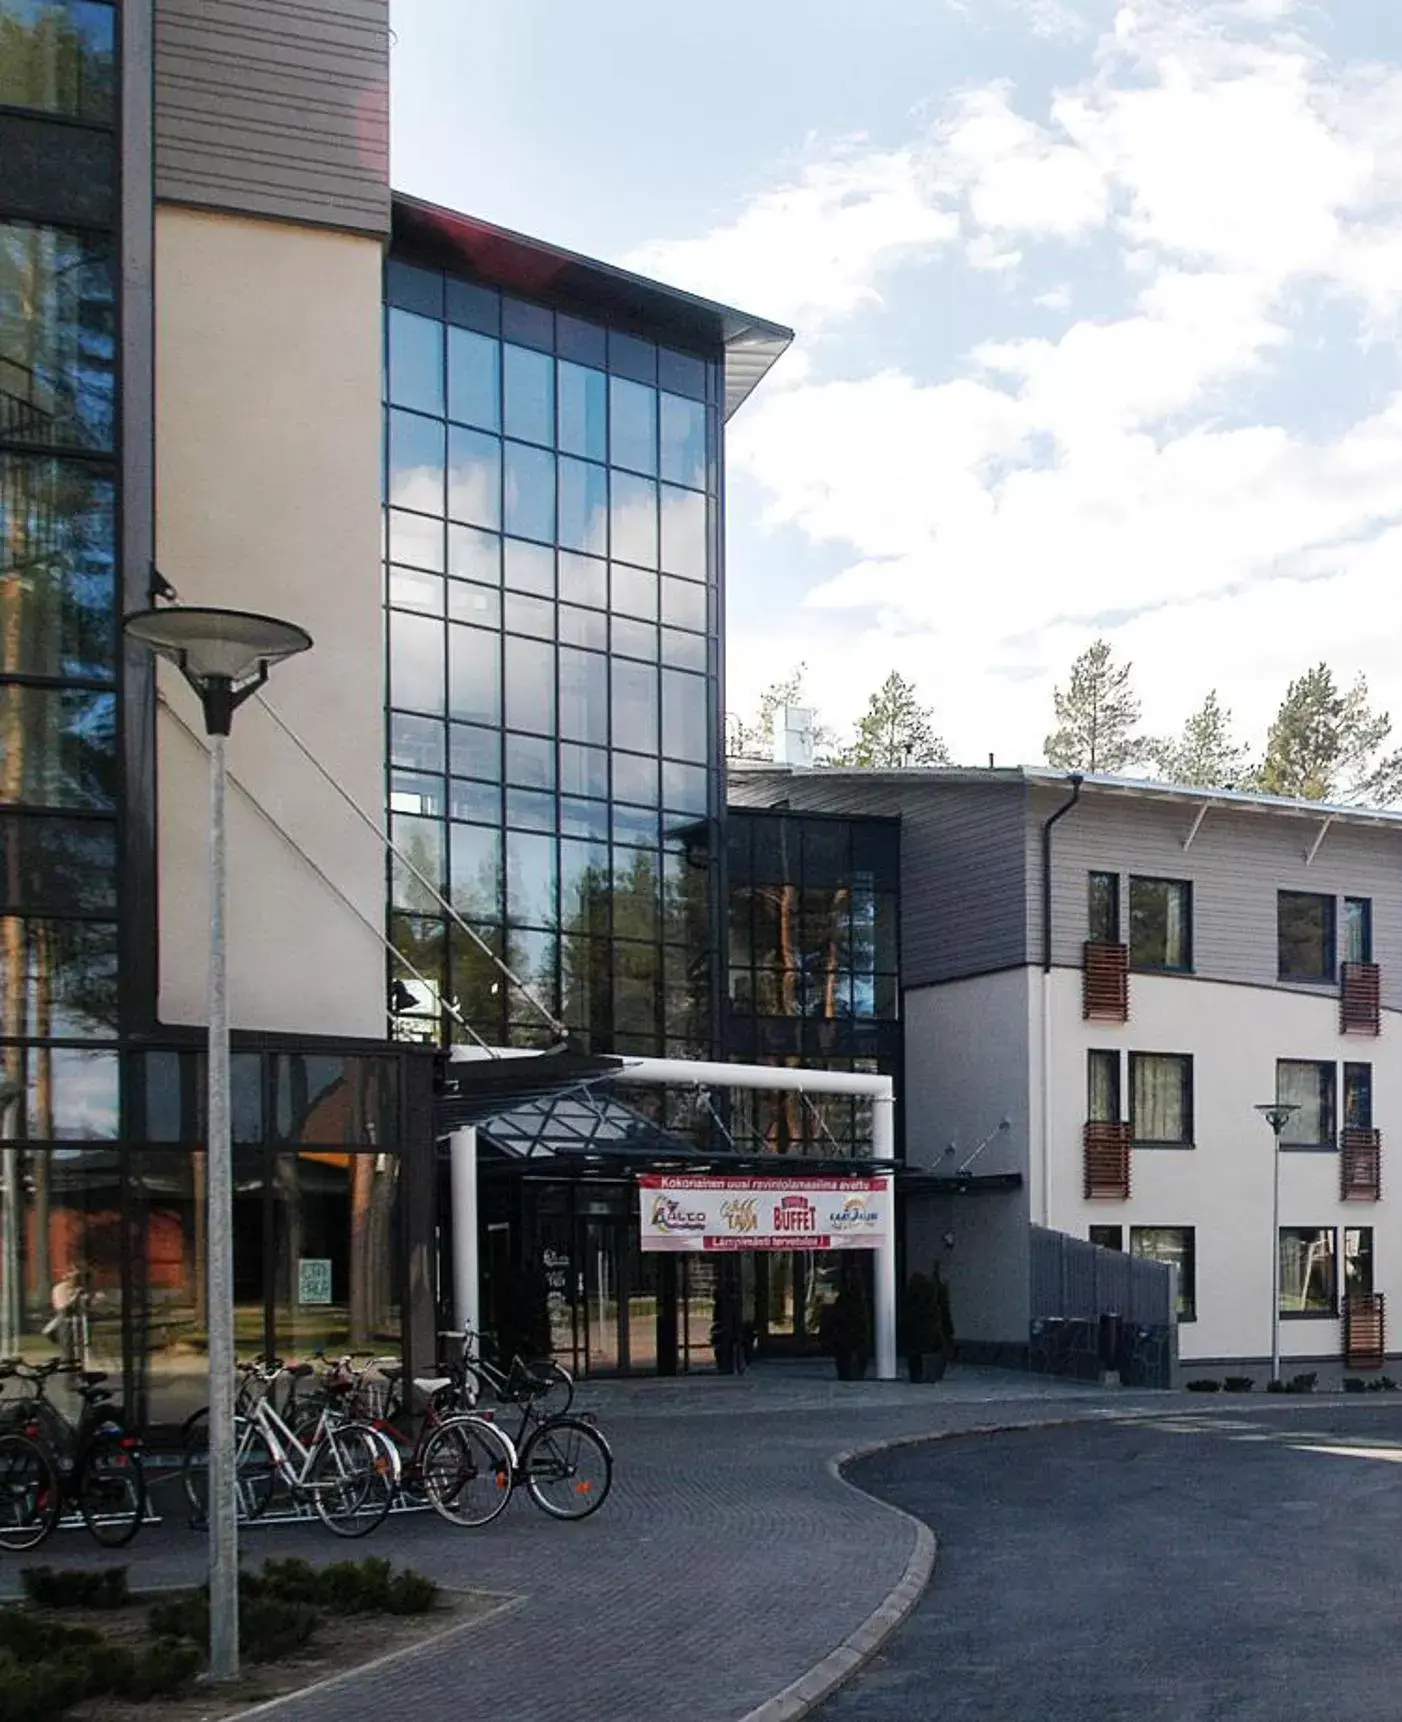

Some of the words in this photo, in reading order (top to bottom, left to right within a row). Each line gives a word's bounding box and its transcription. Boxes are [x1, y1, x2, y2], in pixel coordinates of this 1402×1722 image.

[660, 1176, 725, 1189] Kokonainen
[727, 1178, 750, 1189] uusi
[774, 1205, 816, 1231] BUFFET
